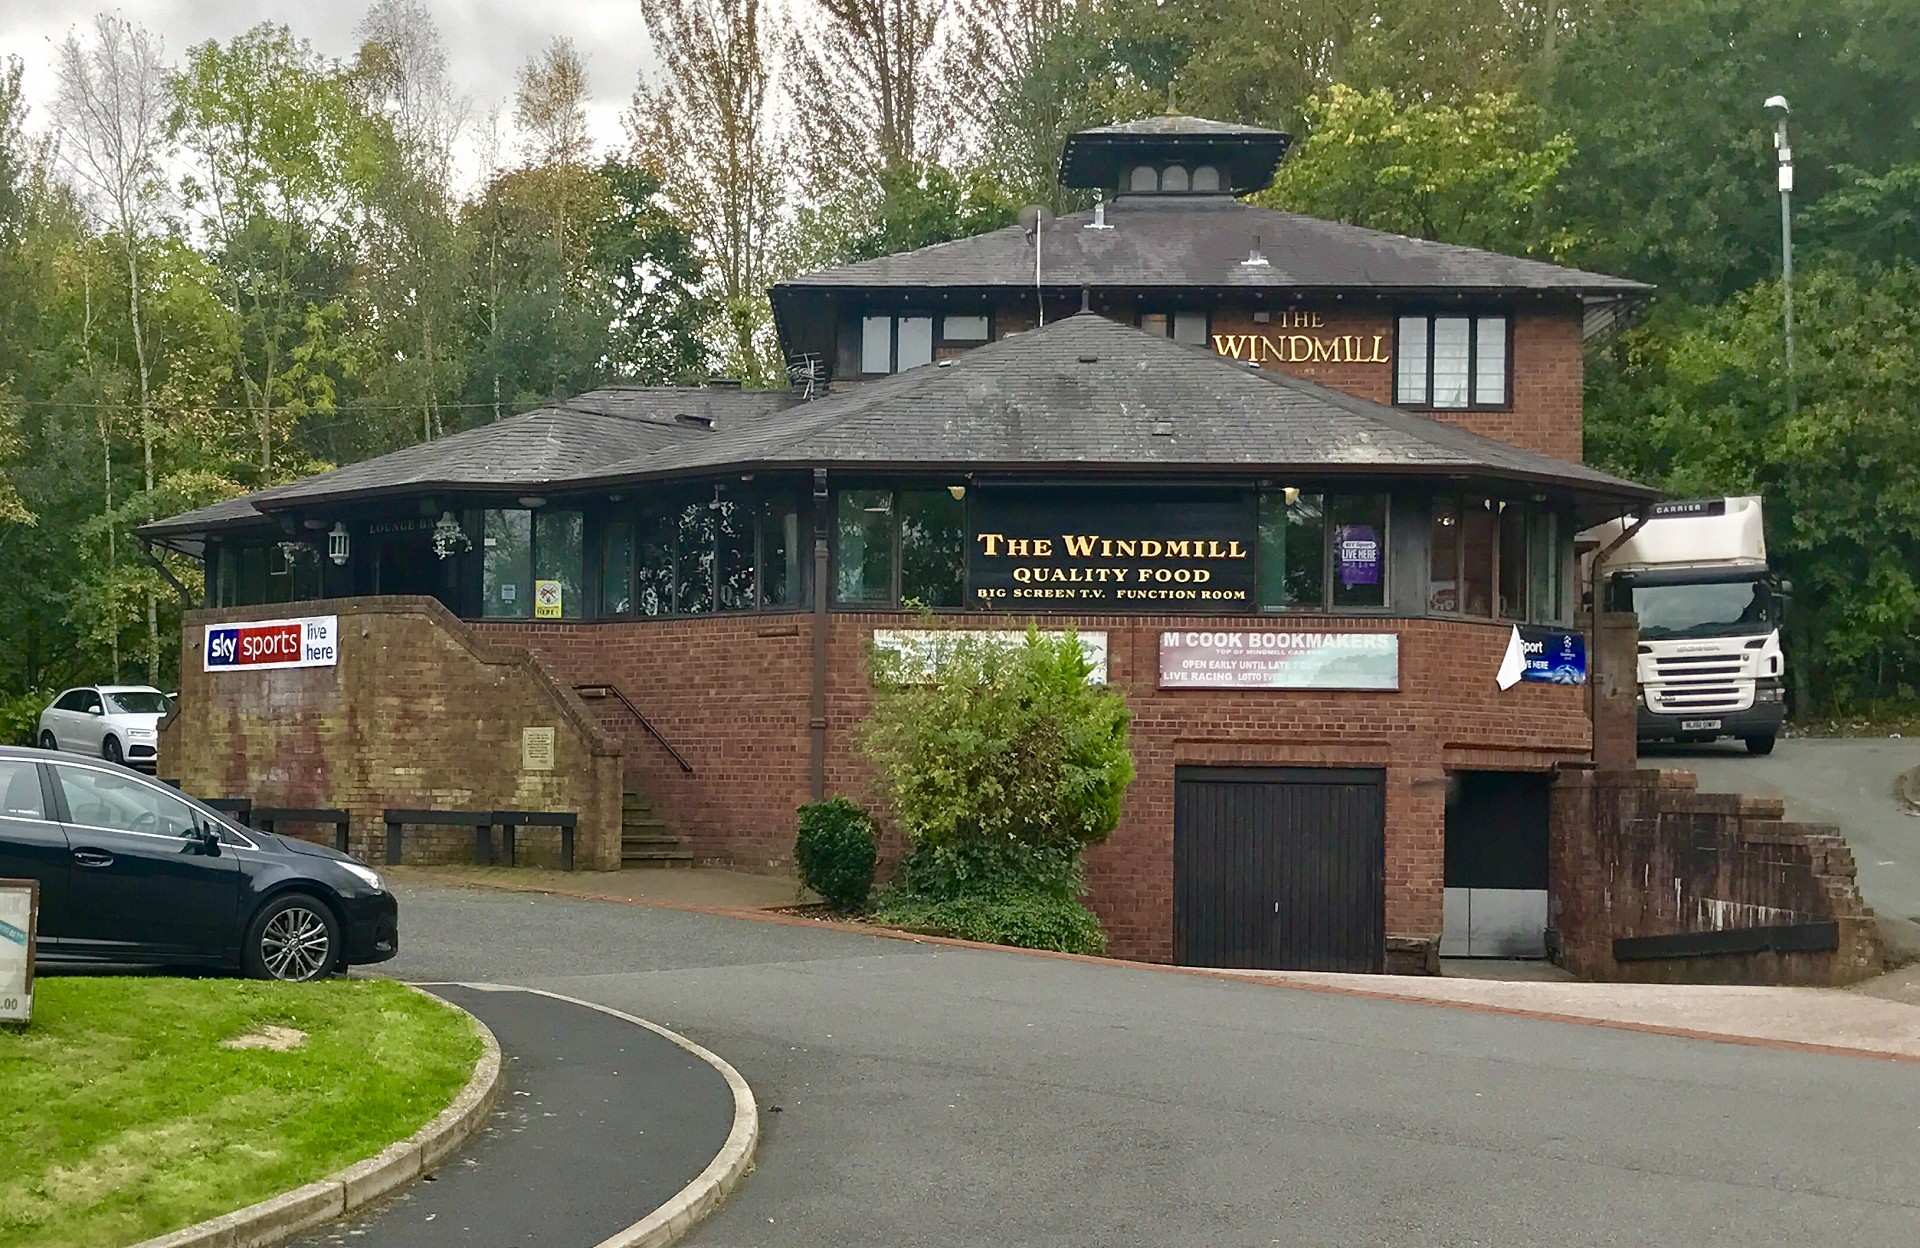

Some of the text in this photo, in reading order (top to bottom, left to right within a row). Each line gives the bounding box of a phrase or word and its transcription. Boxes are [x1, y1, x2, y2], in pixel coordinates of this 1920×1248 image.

[1279, 311, 1324, 328] THE
[1212, 334, 1390, 363] WINDMILL
[1656, 504, 1701, 514] CARRIER
[369, 520, 415, 534] LOUNGE
[1342, 549, 1376, 559] LIVE HERE
[1013, 567, 1211, 583] QUALITY FOOD
[977, 588, 1246, 600] BIG SCREEN T.V. FUNCTION ROOM
[307, 623, 327, 640] live
[211, 631, 298, 662] sky sports
[1163, 632, 1389, 648] M COOK BOOKMAKERS
[306, 644, 333, 660] here
[1182, 660, 1206, 669] OPEN
[1209, 660, 1237, 669] EARLY
[1239, 660, 1266, 670] UNTIL
[1268, 660, 1291, 670] LATE
[1532, 661, 1549, 669] HERE
[1163, 671, 1188, 680] LIVE
[1190, 671, 1233, 681] RACING
[1238, 672, 1261, 681] LOTTO
